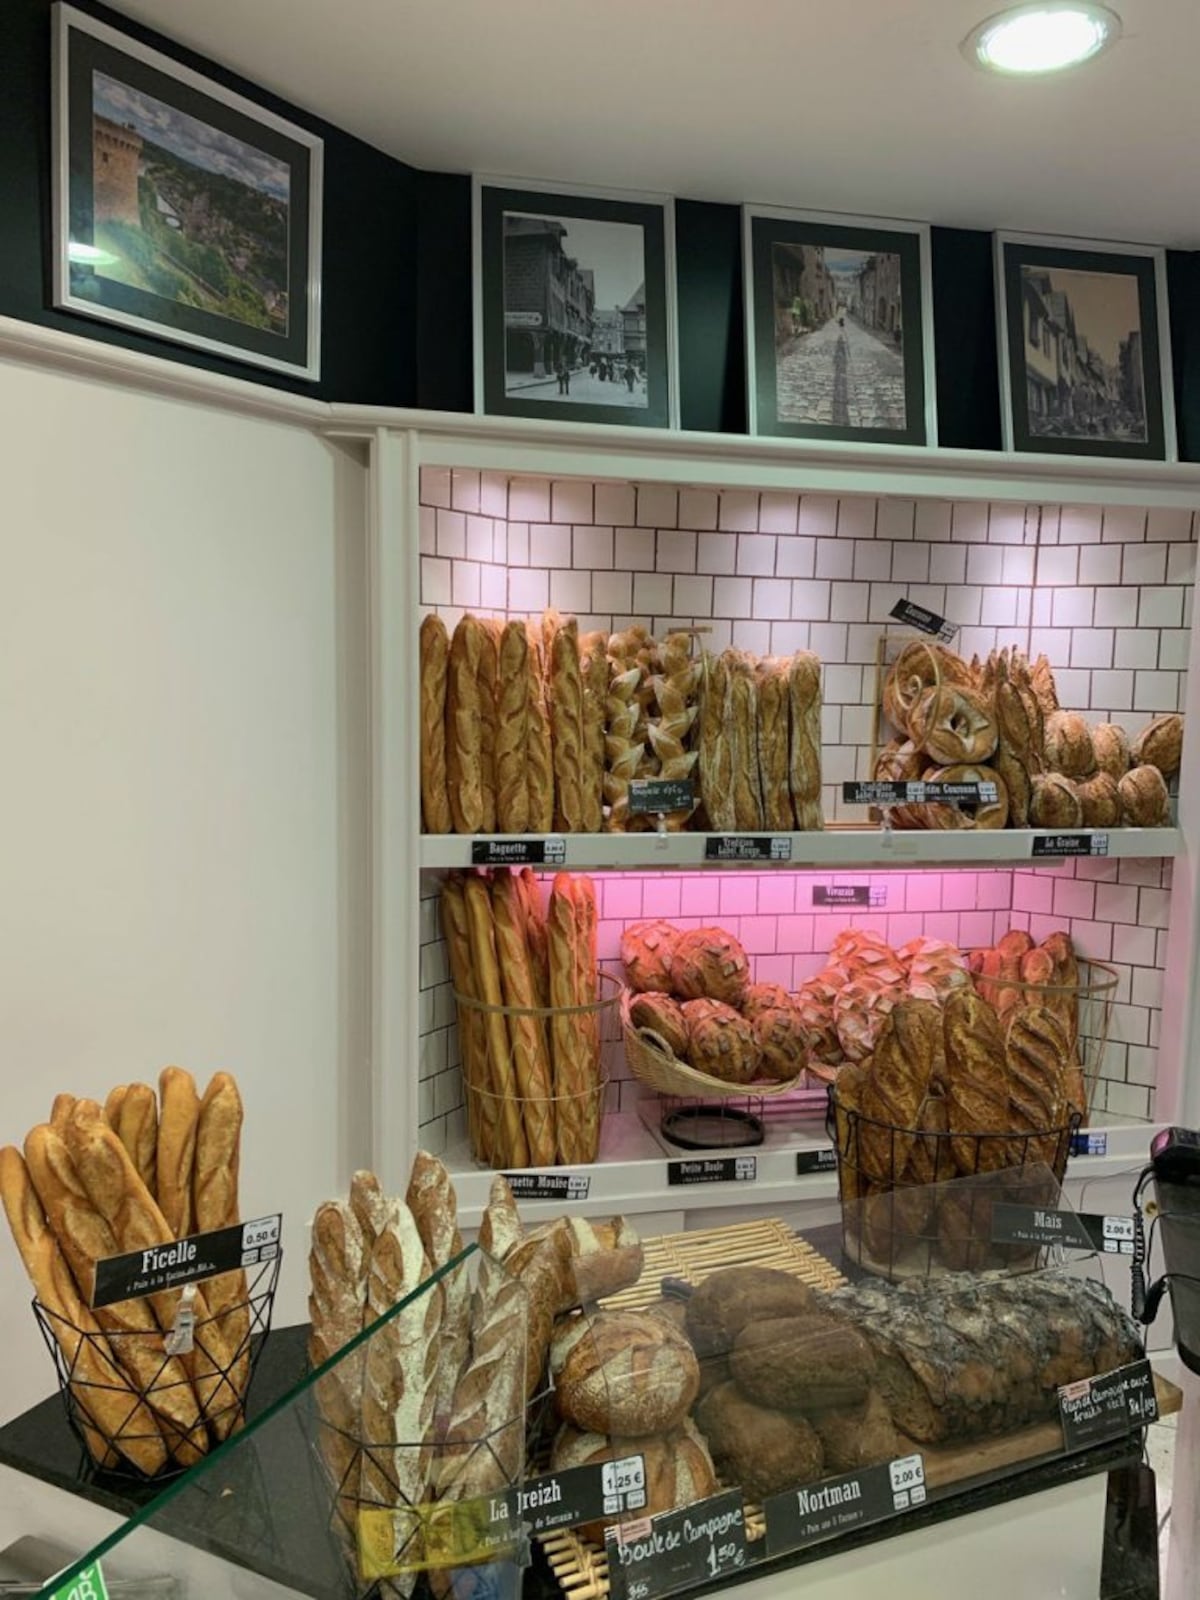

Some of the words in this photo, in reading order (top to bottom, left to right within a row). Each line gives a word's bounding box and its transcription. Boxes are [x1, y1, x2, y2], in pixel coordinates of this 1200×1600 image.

[489, 842, 528, 855] Baguette
[246, 1230, 268, 1245] 0.50
[270, 1227, 278, 1238] €
[1106, 1225, 1124, 1234] 2.00
[141, 1240, 197, 1274] Ficelle
[607, 1474, 631, 1489] 1.25
[634, 1471, 642, 1484] €
[893, 1470, 914, 1486] 2.00
[915, 1467, 923, 1479] €
[797, 1480, 862, 1517] Nortman
[489, 1499, 509, 1522] La
[665, 1532, 681, 1551] de
[683, 1509, 744, 1543] Campagne
